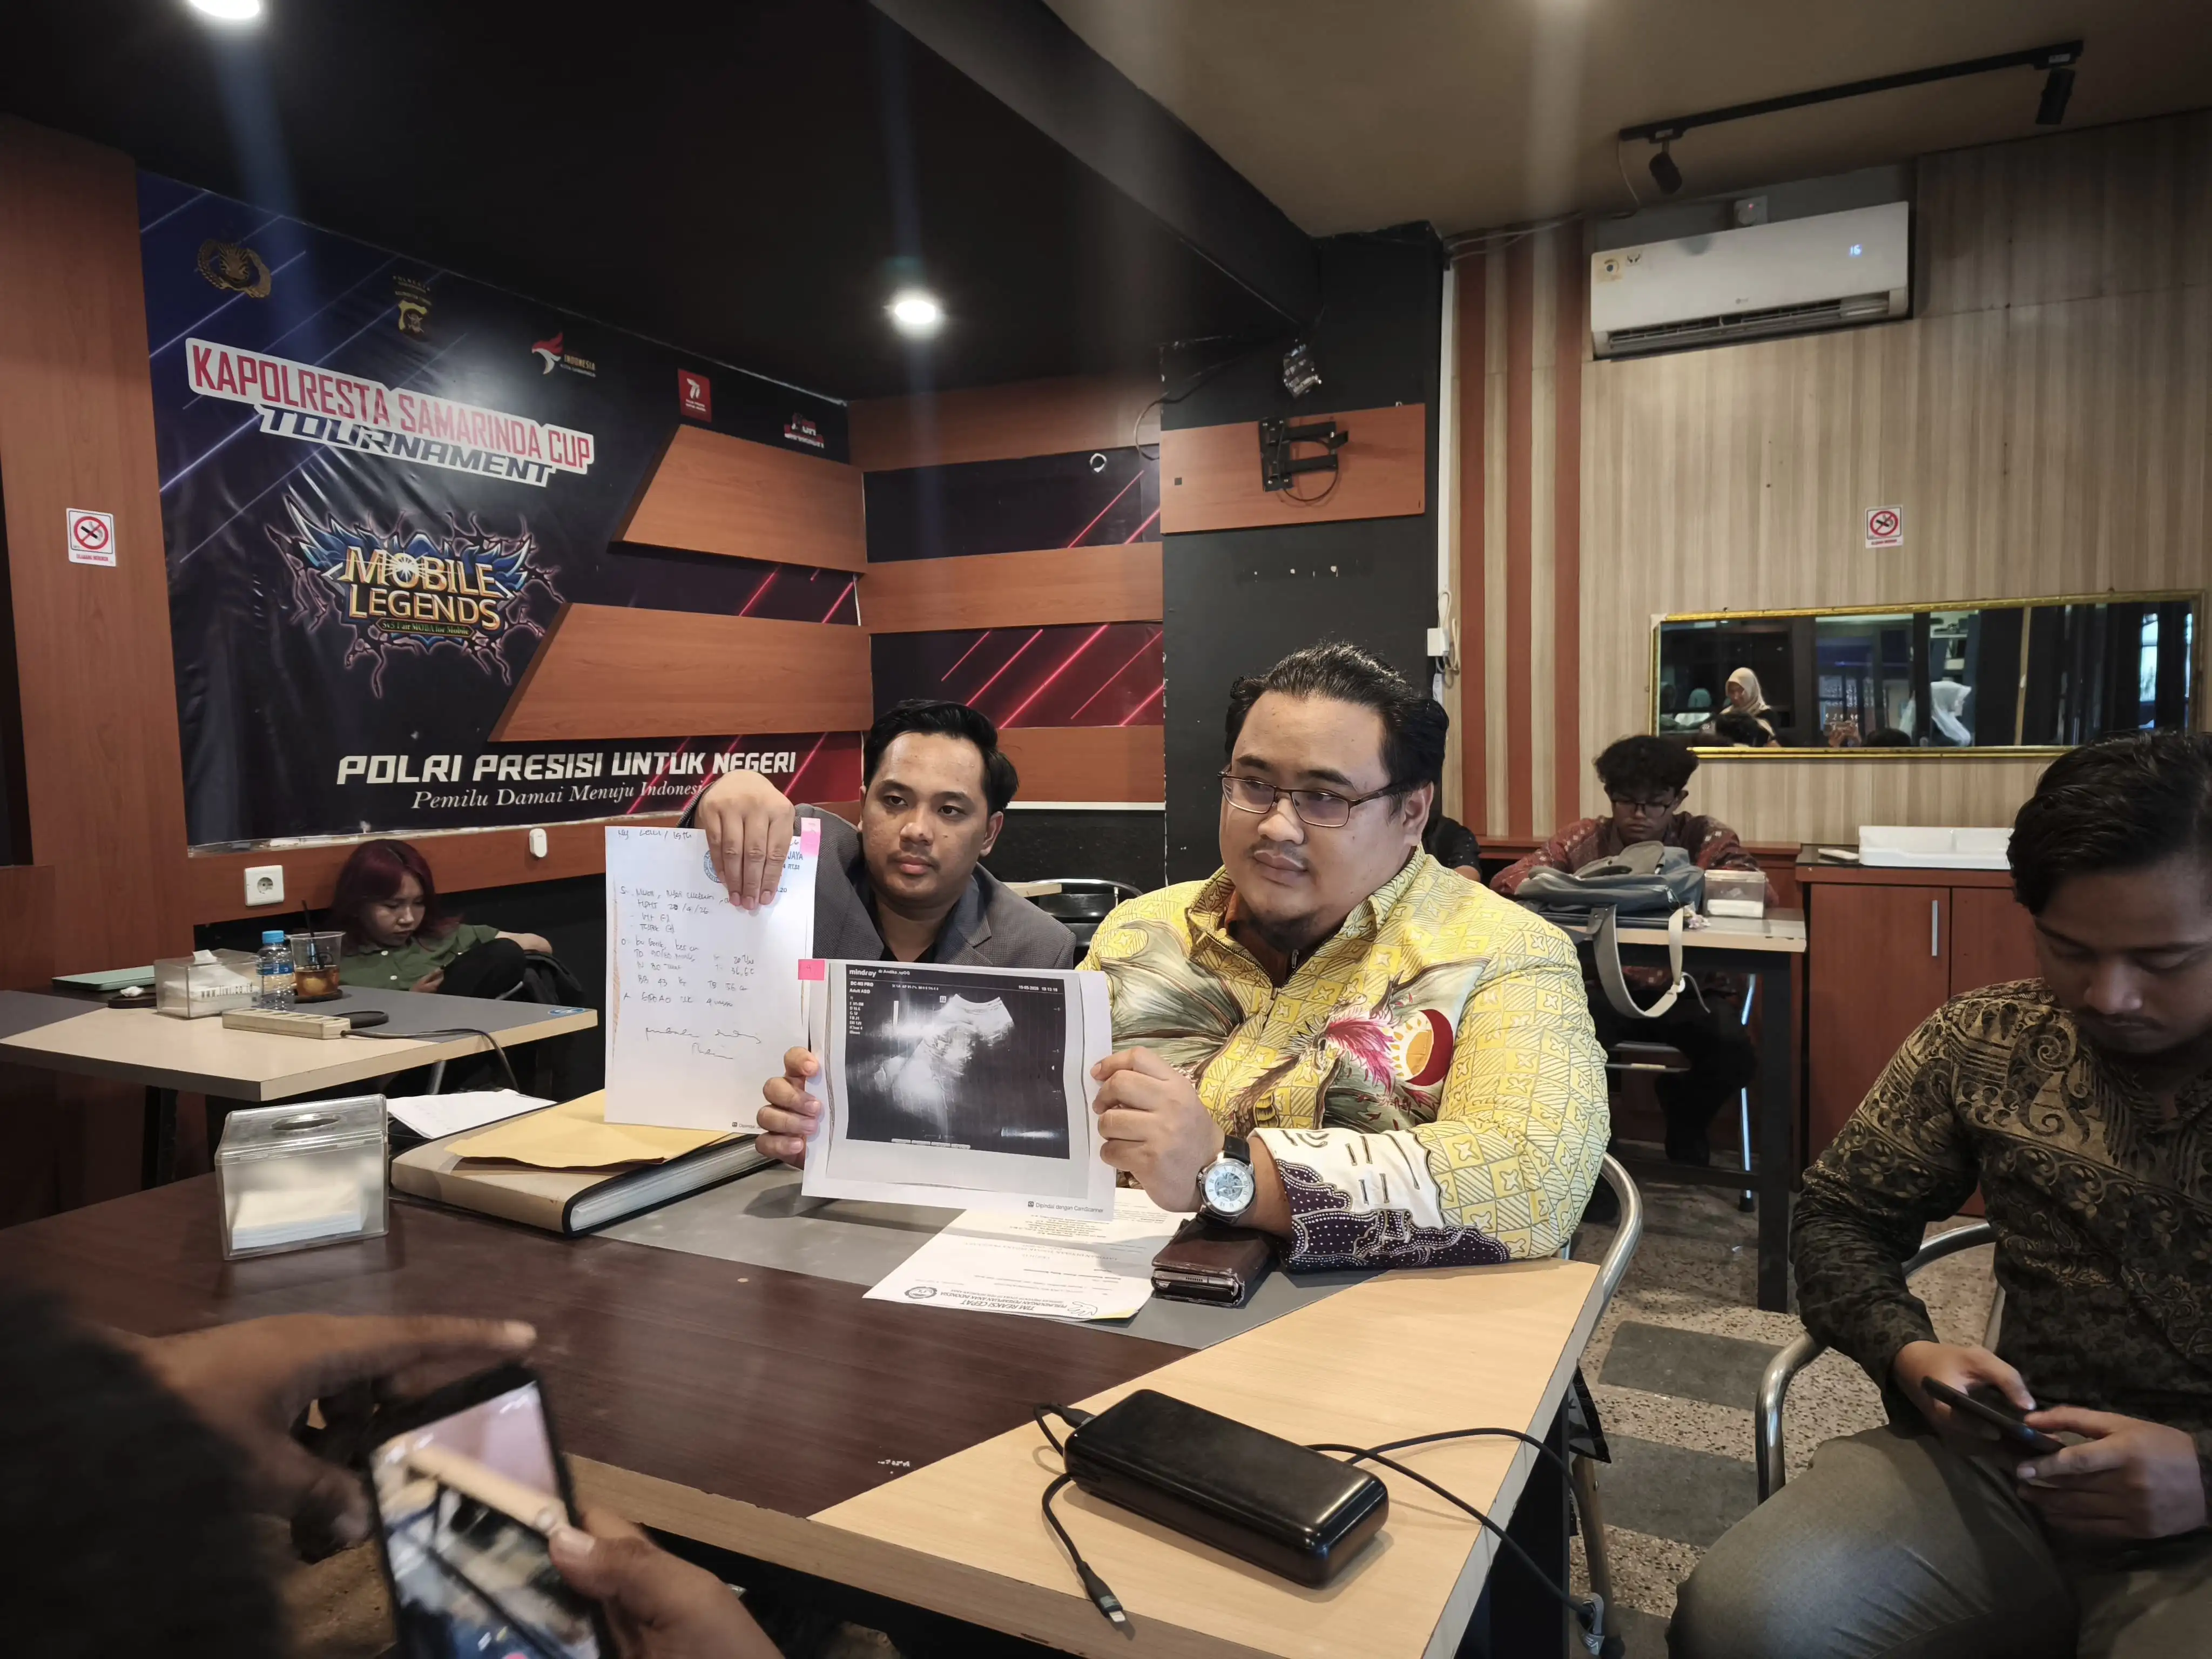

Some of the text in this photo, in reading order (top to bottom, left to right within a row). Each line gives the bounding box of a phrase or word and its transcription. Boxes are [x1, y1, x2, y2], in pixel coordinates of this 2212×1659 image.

[564, 354, 596, 370] INDONESIA
[192, 345, 590, 469] KAPOLRESTA SAMARINDA CUP
[261, 404, 553, 483] TOURNAMENT
[340, 546, 504, 598] MOBILE
[349, 584, 502, 631] LEGENDS
[412, 623, 434, 631] MOBA
[447, 626, 469, 635] Mobile
[337, 752, 796, 785] POLRI PRESISI UNTUK NEGERI
[411, 780, 704, 810] Pemilu Damai Menuju Indonesi
[788, 851, 803, 860] JAYA
[849, 968, 877, 978] mindray
[1074, 1205, 1104, 1213] CamScanner
[960, 1299, 987, 1307] CEPAT
